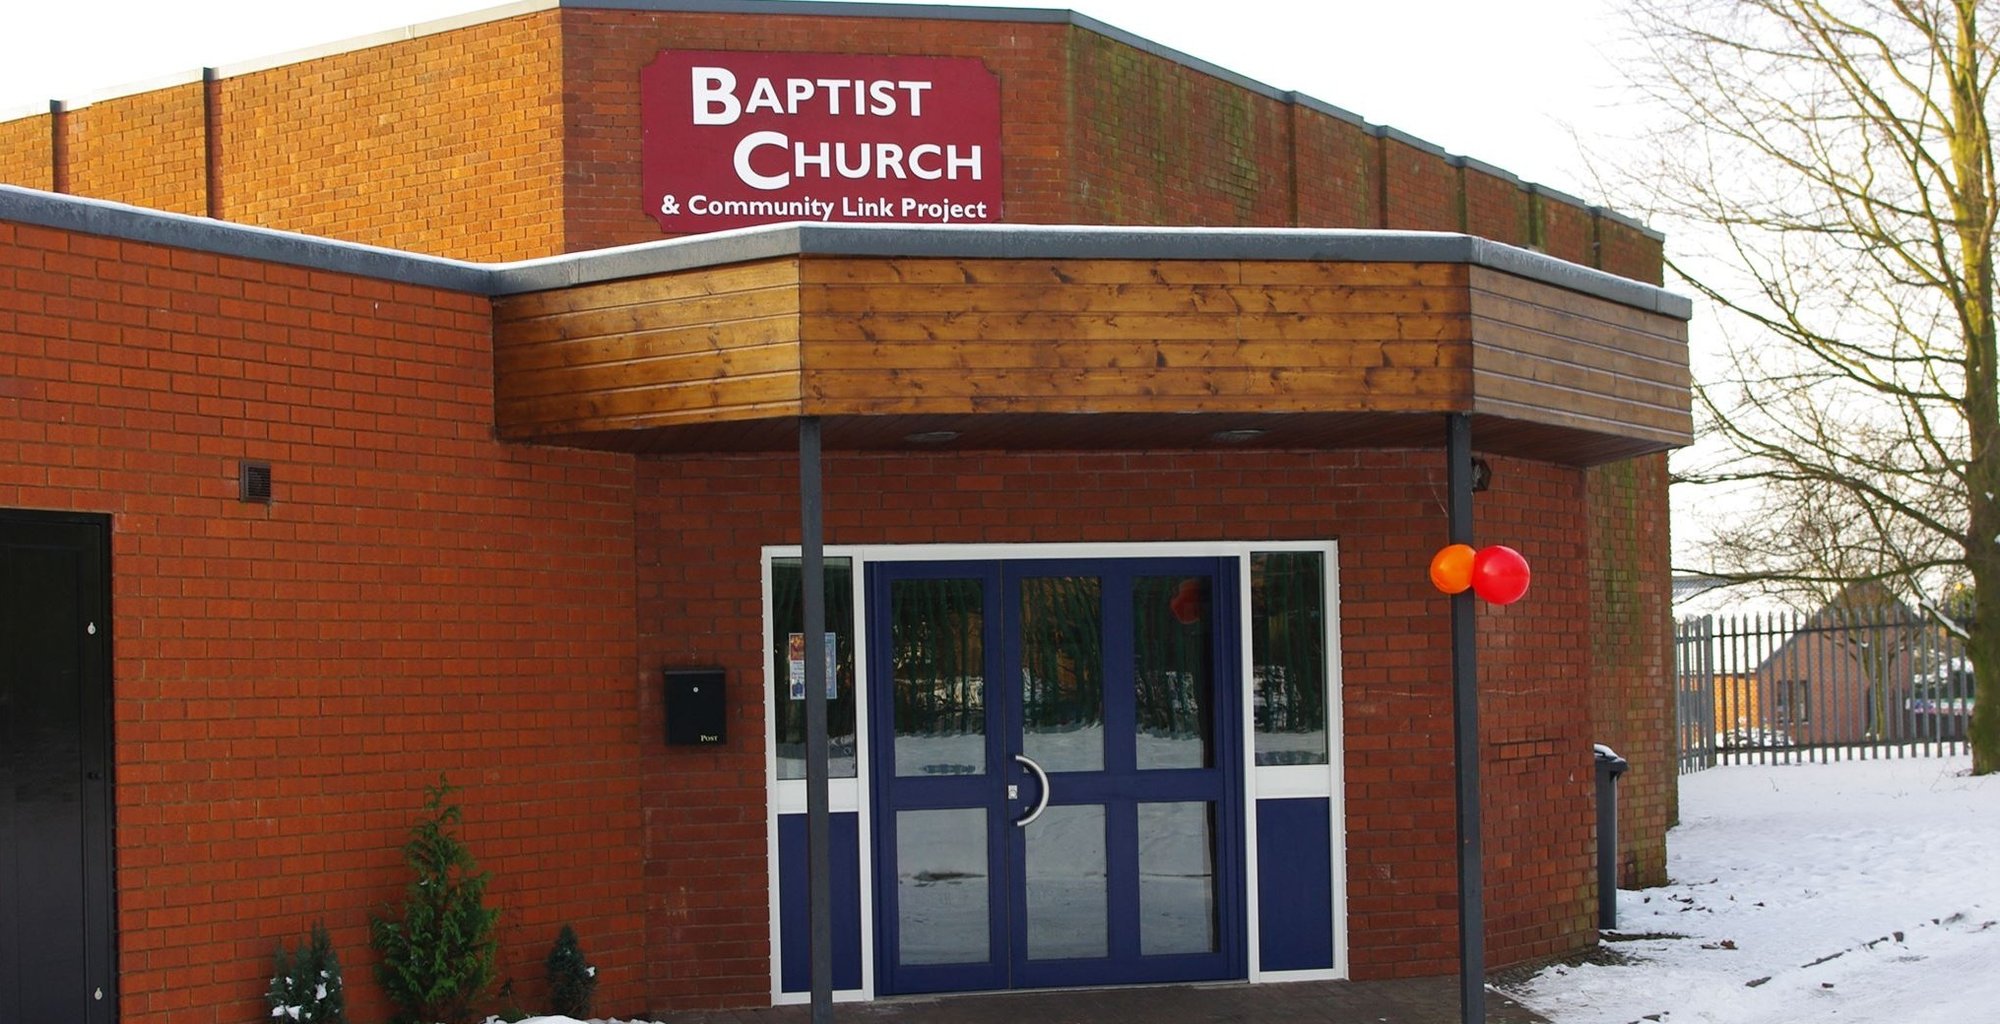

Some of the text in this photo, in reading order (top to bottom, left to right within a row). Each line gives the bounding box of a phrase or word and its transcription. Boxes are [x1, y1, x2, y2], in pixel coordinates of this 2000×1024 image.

[691, 66, 932, 125] BAPTIST
[733, 131, 982, 190] CHURCH
[661, 194, 987, 222] & Community Link Project
